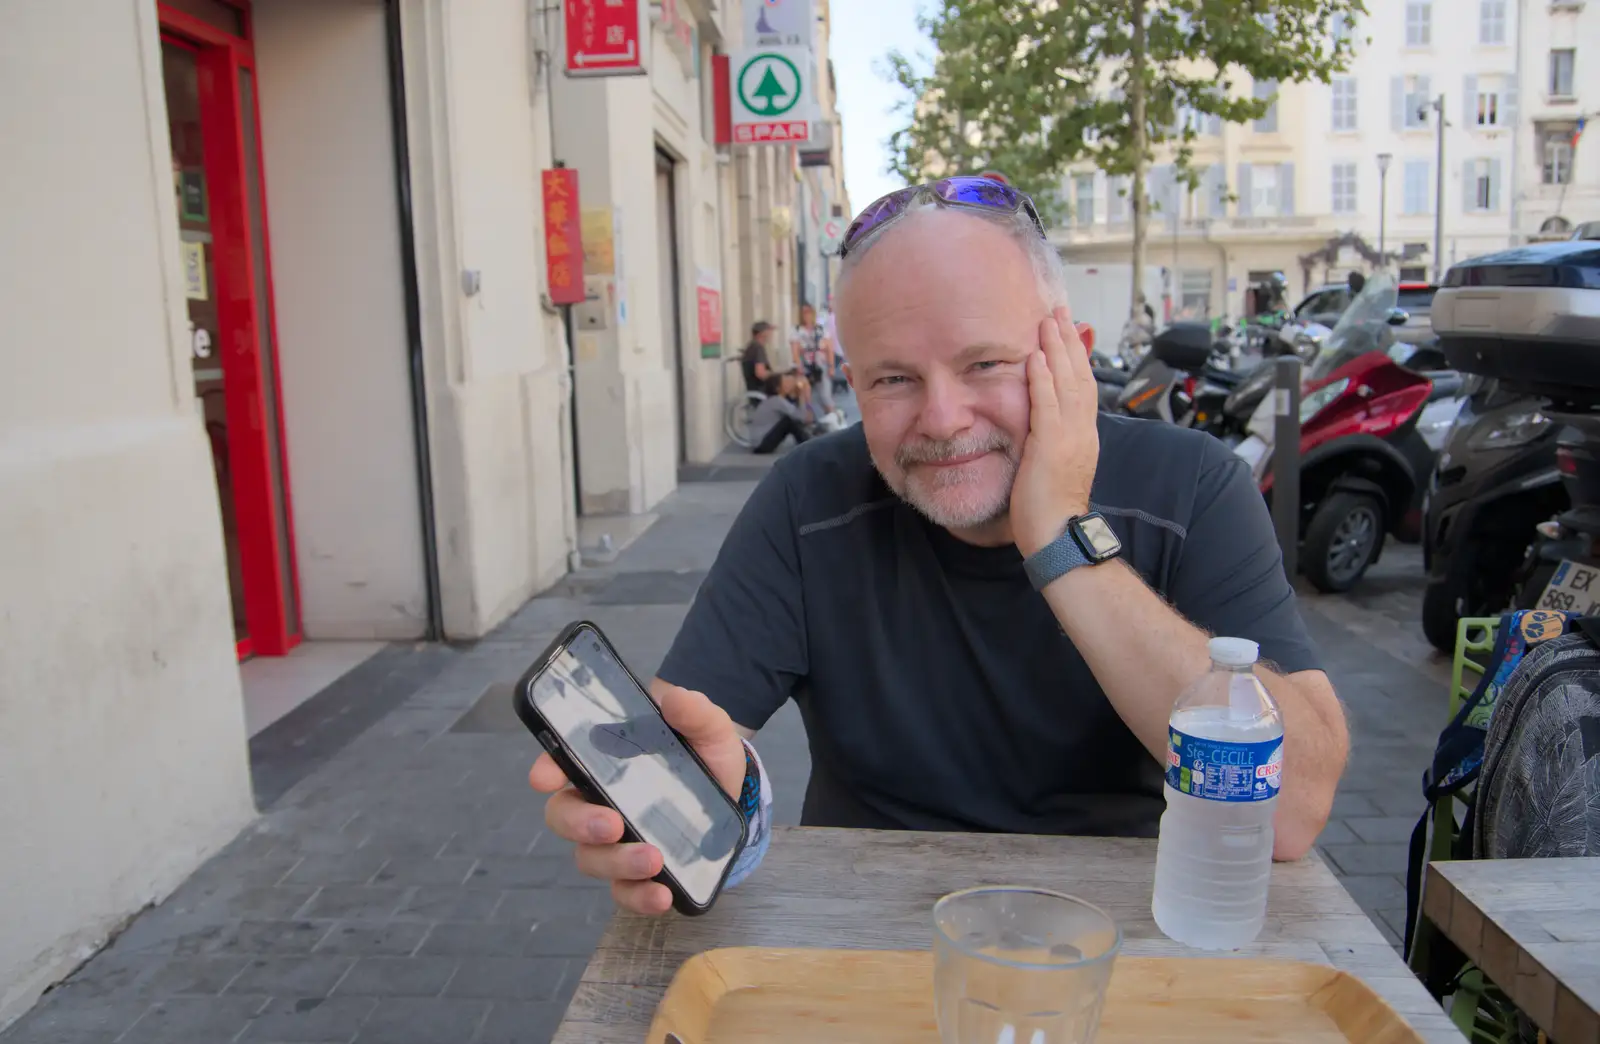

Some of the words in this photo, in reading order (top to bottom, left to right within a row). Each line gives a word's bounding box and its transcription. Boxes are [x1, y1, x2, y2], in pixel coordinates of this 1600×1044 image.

[737, 123, 805, 140] SPAR
[1570, 569, 1598, 592] EX
[1186, 743, 1255, 765] Ste-CECILE
[1257, 761, 1282, 777] CRIS
